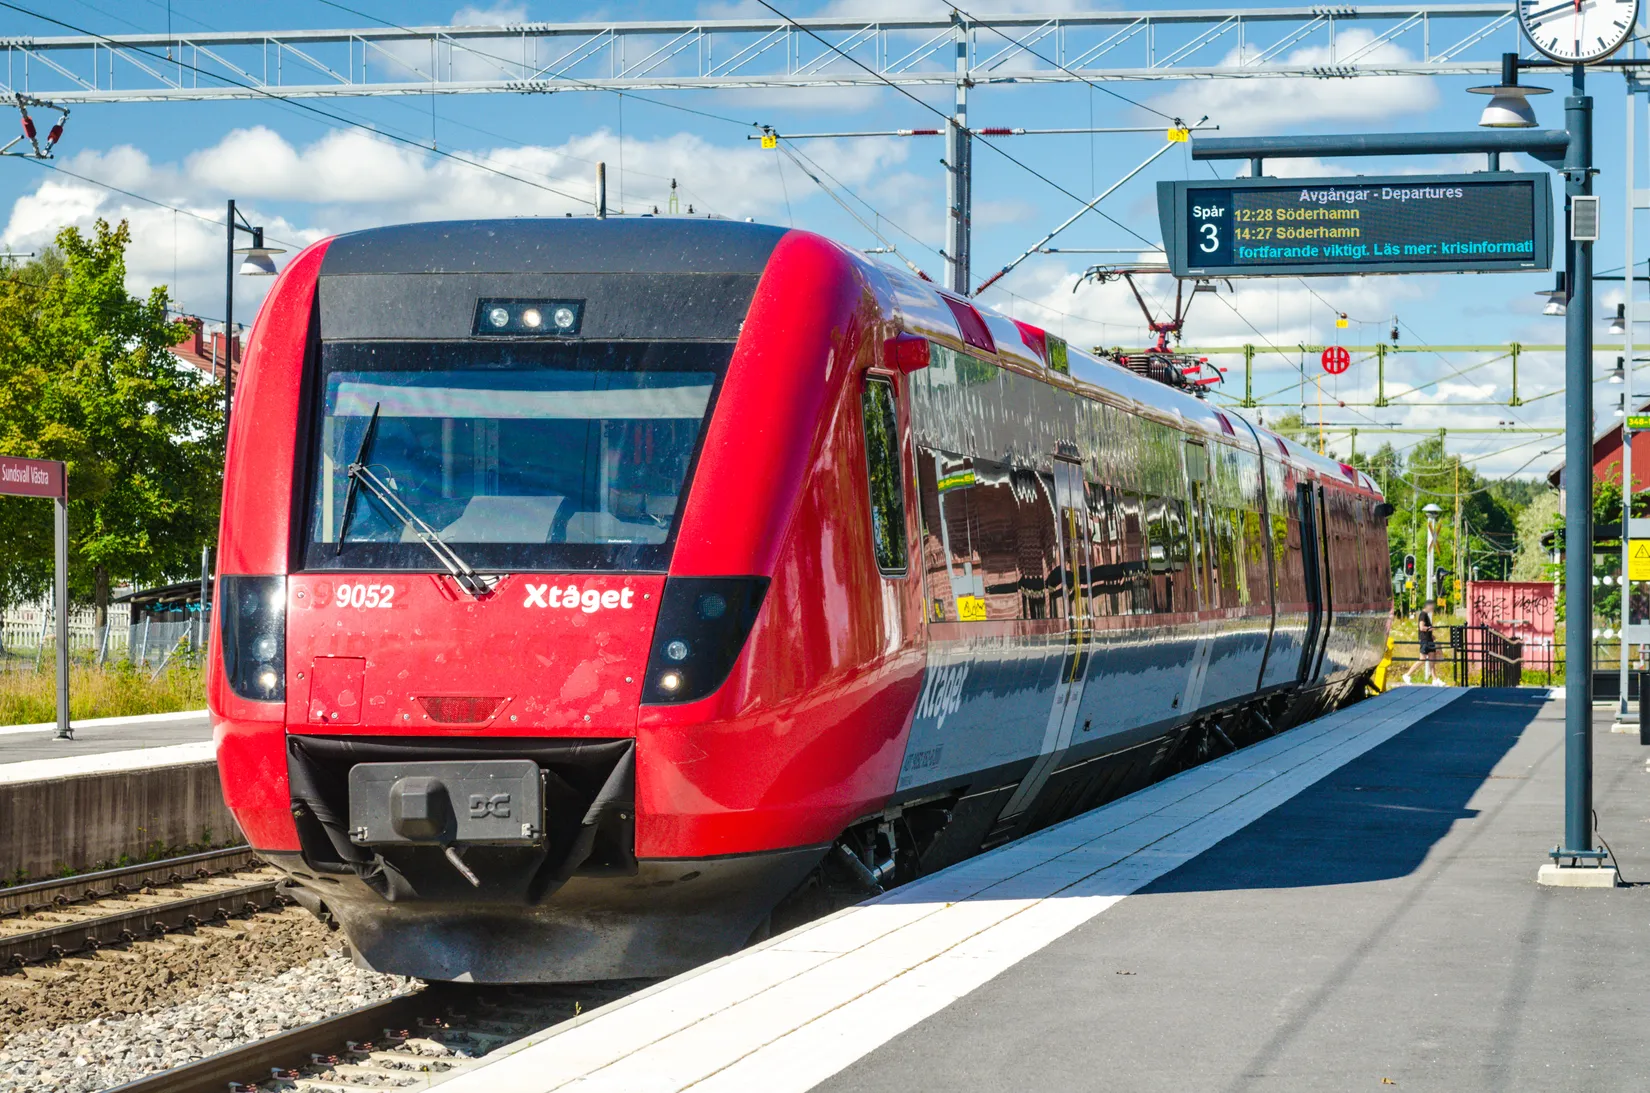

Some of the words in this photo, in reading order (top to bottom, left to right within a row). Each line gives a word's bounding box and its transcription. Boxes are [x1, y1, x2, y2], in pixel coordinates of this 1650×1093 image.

[1299, 187, 1371, 204] Avgångar
[1382, 187, 1463, 202] Departures
[1193, 205, 1225, 220] Spår
[1234, 208, 1273, 222] 12:28
[1276, 208, 1360, 221] Söderhamn
[1199, 223, 1220, 253] 3
[1234, 227, 1273, 240] 14:27
[1276, 226, 1361, 239] Söderhamn
[1239, 245, 1319, 259] fortfarande
[1323, 244, 1370, 259] viktigt.
[1373, 243, 1400, 256] Läs
[1404, 243, 1437, 255] mer:
[1441, 239, 1533, 254] krisinformati
[2, 463, 30, 483] Sundsvall
[31, 466, 49, 485] Västra
[336, 584, 395, 609] 9052
[523, 583, 635, 613] Xtåget
